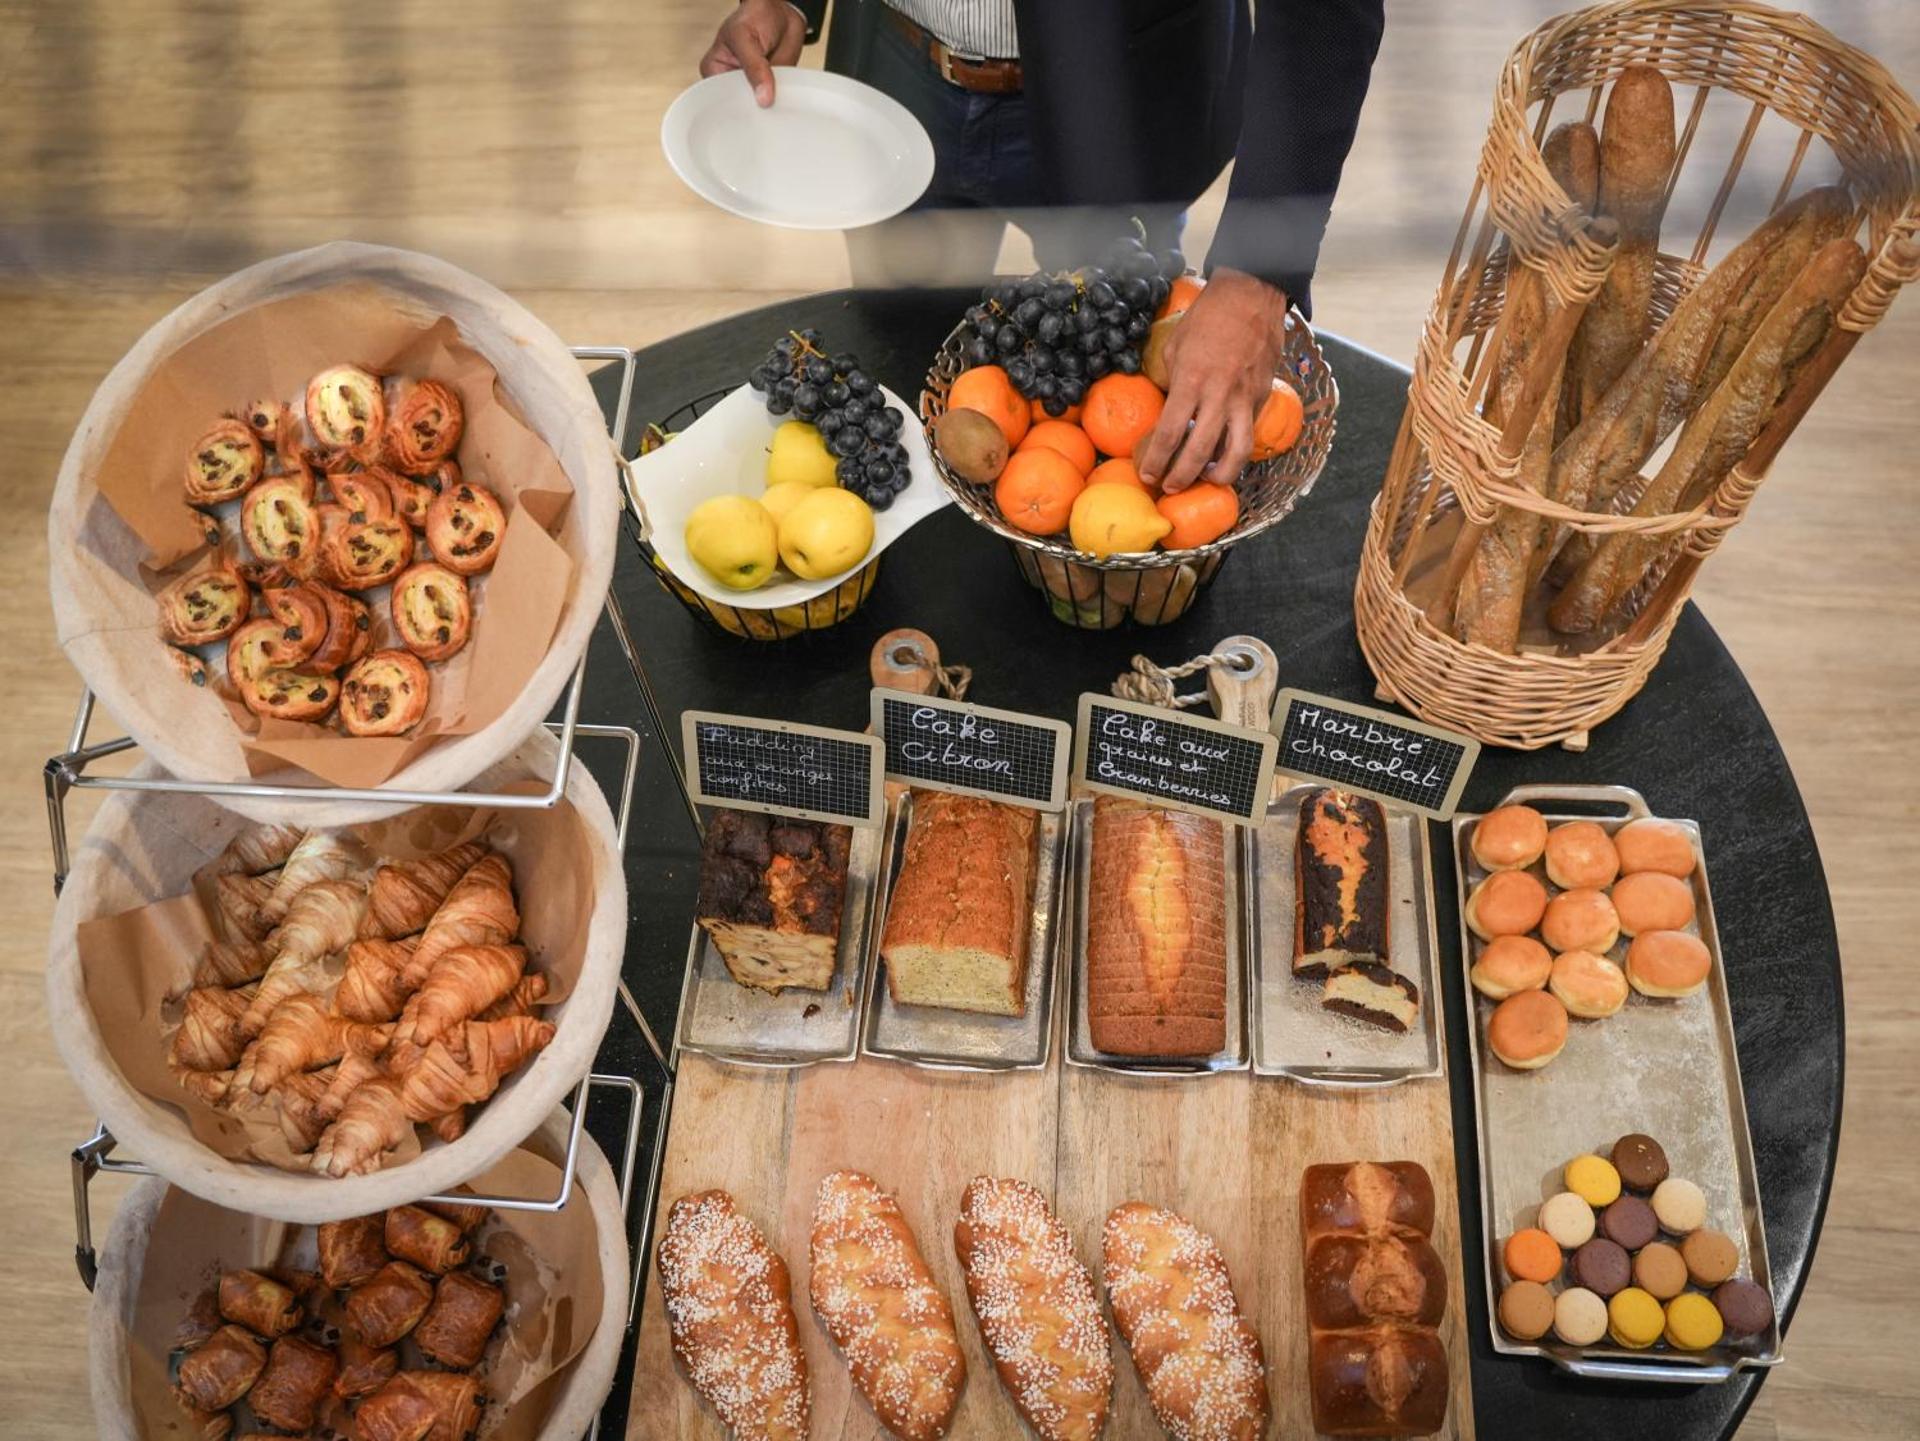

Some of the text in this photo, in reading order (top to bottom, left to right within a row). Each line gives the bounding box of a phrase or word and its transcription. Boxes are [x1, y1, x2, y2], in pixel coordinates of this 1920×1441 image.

[912, 707, 999, 744] Cake
[1103, 714, 1230, 762] Cake aux
[1299, 709, 1430, 755] Marbré
[703, 727, 816, 763] Pudding
[1099, 742, 1207, 772] graines et
[755, 763, 833, 785] oranges
[1098, 762, 1231, 805] Cranberries
